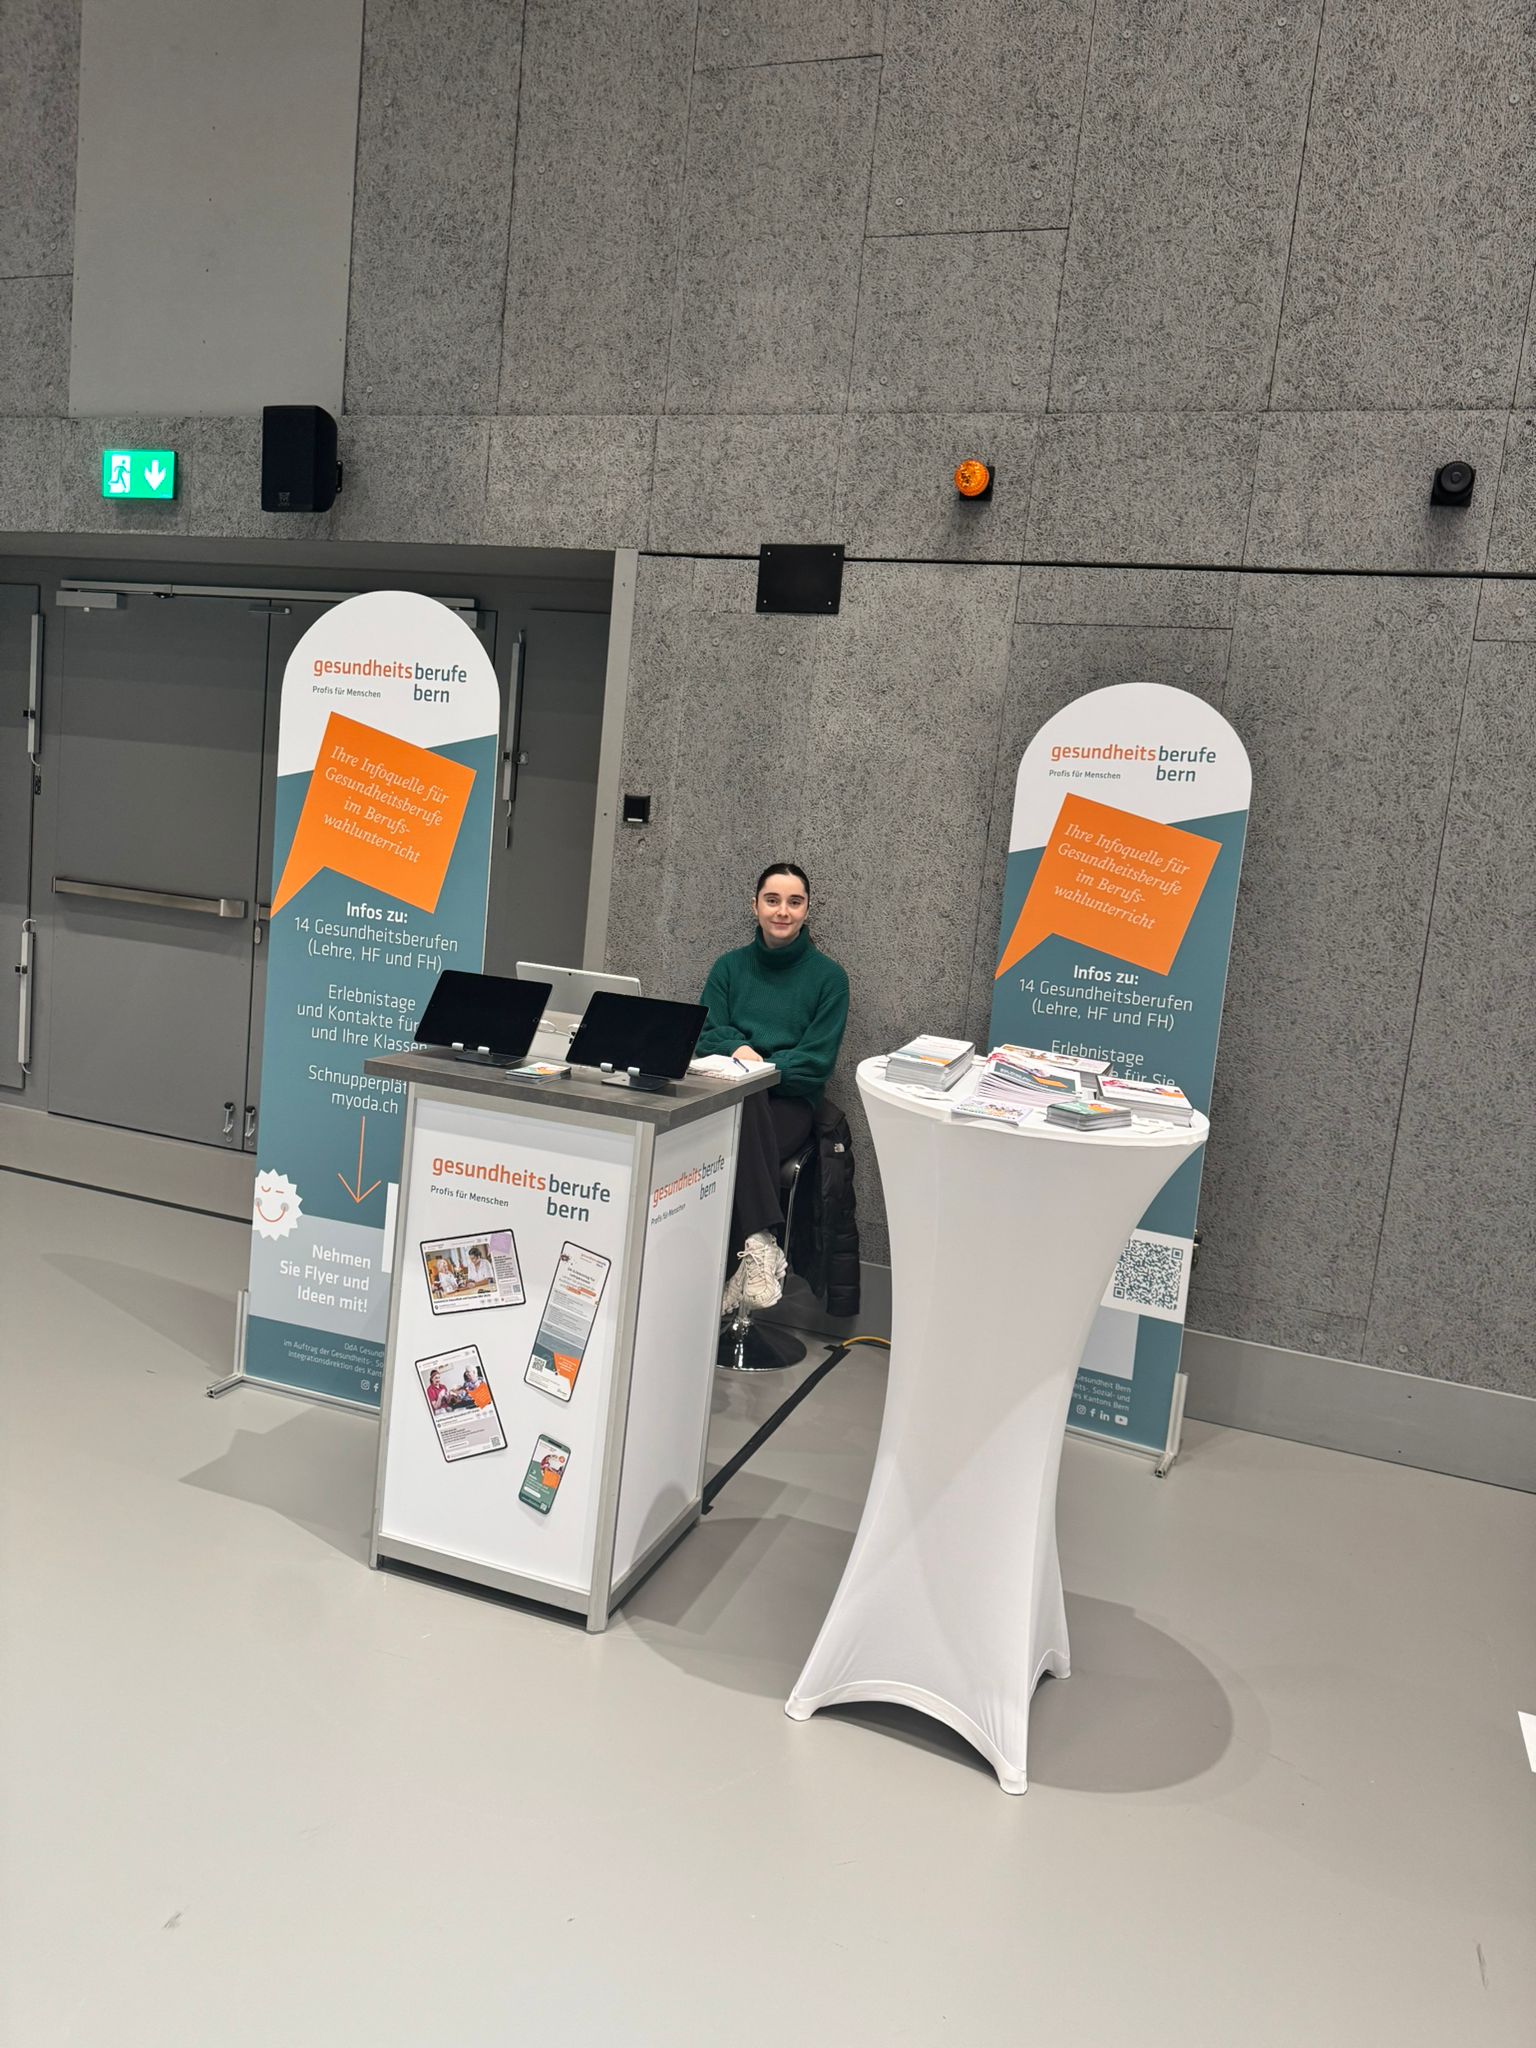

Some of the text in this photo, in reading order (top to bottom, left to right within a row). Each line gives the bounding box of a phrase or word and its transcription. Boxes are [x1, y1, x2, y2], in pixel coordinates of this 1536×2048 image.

[312, 685, 381, 698] Profis für Menschen
[413, 684, 450, 703] bern
[330, 745, 449, 804] Ihre Infoquelle für
[1049, 769, 1121, 780] Profis für Menschen
[1156, 765, 1197, 782] bern
[325, 767, 444, 827] Gesundheitsberufe
[343, 797, 411, 835] im Berufs-
[323, 813, 421, 864] wahlunterricht
[1064, 823, 1190, 875] Ihre Infoquelle für
[1057, 843, 1182, 896] Gesundheitsberufe
[1075, 869, 1146, 904] im Berufs-
[346, 901, 408, 923] Infos zu:
[1054, 885, 1157, 929] wahlunterricht
[294, 916, 458, 952] 14 Gesundheitsberufen
[308, 937, 442, 974] (Lehre, HF und FH)
[1073, 964, 1139, 985] Infos zu:
[328, 984, 416, 1013] Erlebnistage
[1019, 978, 1193, 1012] 14 Gesundheitsberufen
[297, 1003, 419, 1032] und Kontakte für
[1032, 998, 1175, 1032] (Lehre, HF und FH)
[311, 1026, 337, 1042] und
[343, 1029, 369, 1047] Ihre
[1052, 1040, 1144, 1068] Erlebnistage
[308, 1064, 407, 1095] Schnupperplät
[1124, 1069, 1147, 1082] für
[1153, 1073, 1175, 1086] Sie
[331, 1092, 398, 1114] myoda.ch
[430, 1185, 509, 1208] Profis für Menschen
[700, 1181, 717, 1200] bern
[546, 1197, 589, 1222] bern
[312, 1244, 371, 1269] Nehmen
[280, 1260, 370, 1291] Sie Flyer und
[298, 1285, 368, 1313] Ideen mit!
[283, 1339, 292, 1347] im
[293, 1341, 318, 1355] Auftrag
[319, 1347, 330, 1356] der
[359, 1346, 385, 1358] Gesund
[288, 1351, 384, 1378] Integrationsdirektion des Kant
[1115, 1383, 1131, 1393] Bern
[1117, 1394, 1131, 1403] und
[1083, 1394, 1111, 1407] Kantons
[1113, 1401, 1130, 1412] Bern
